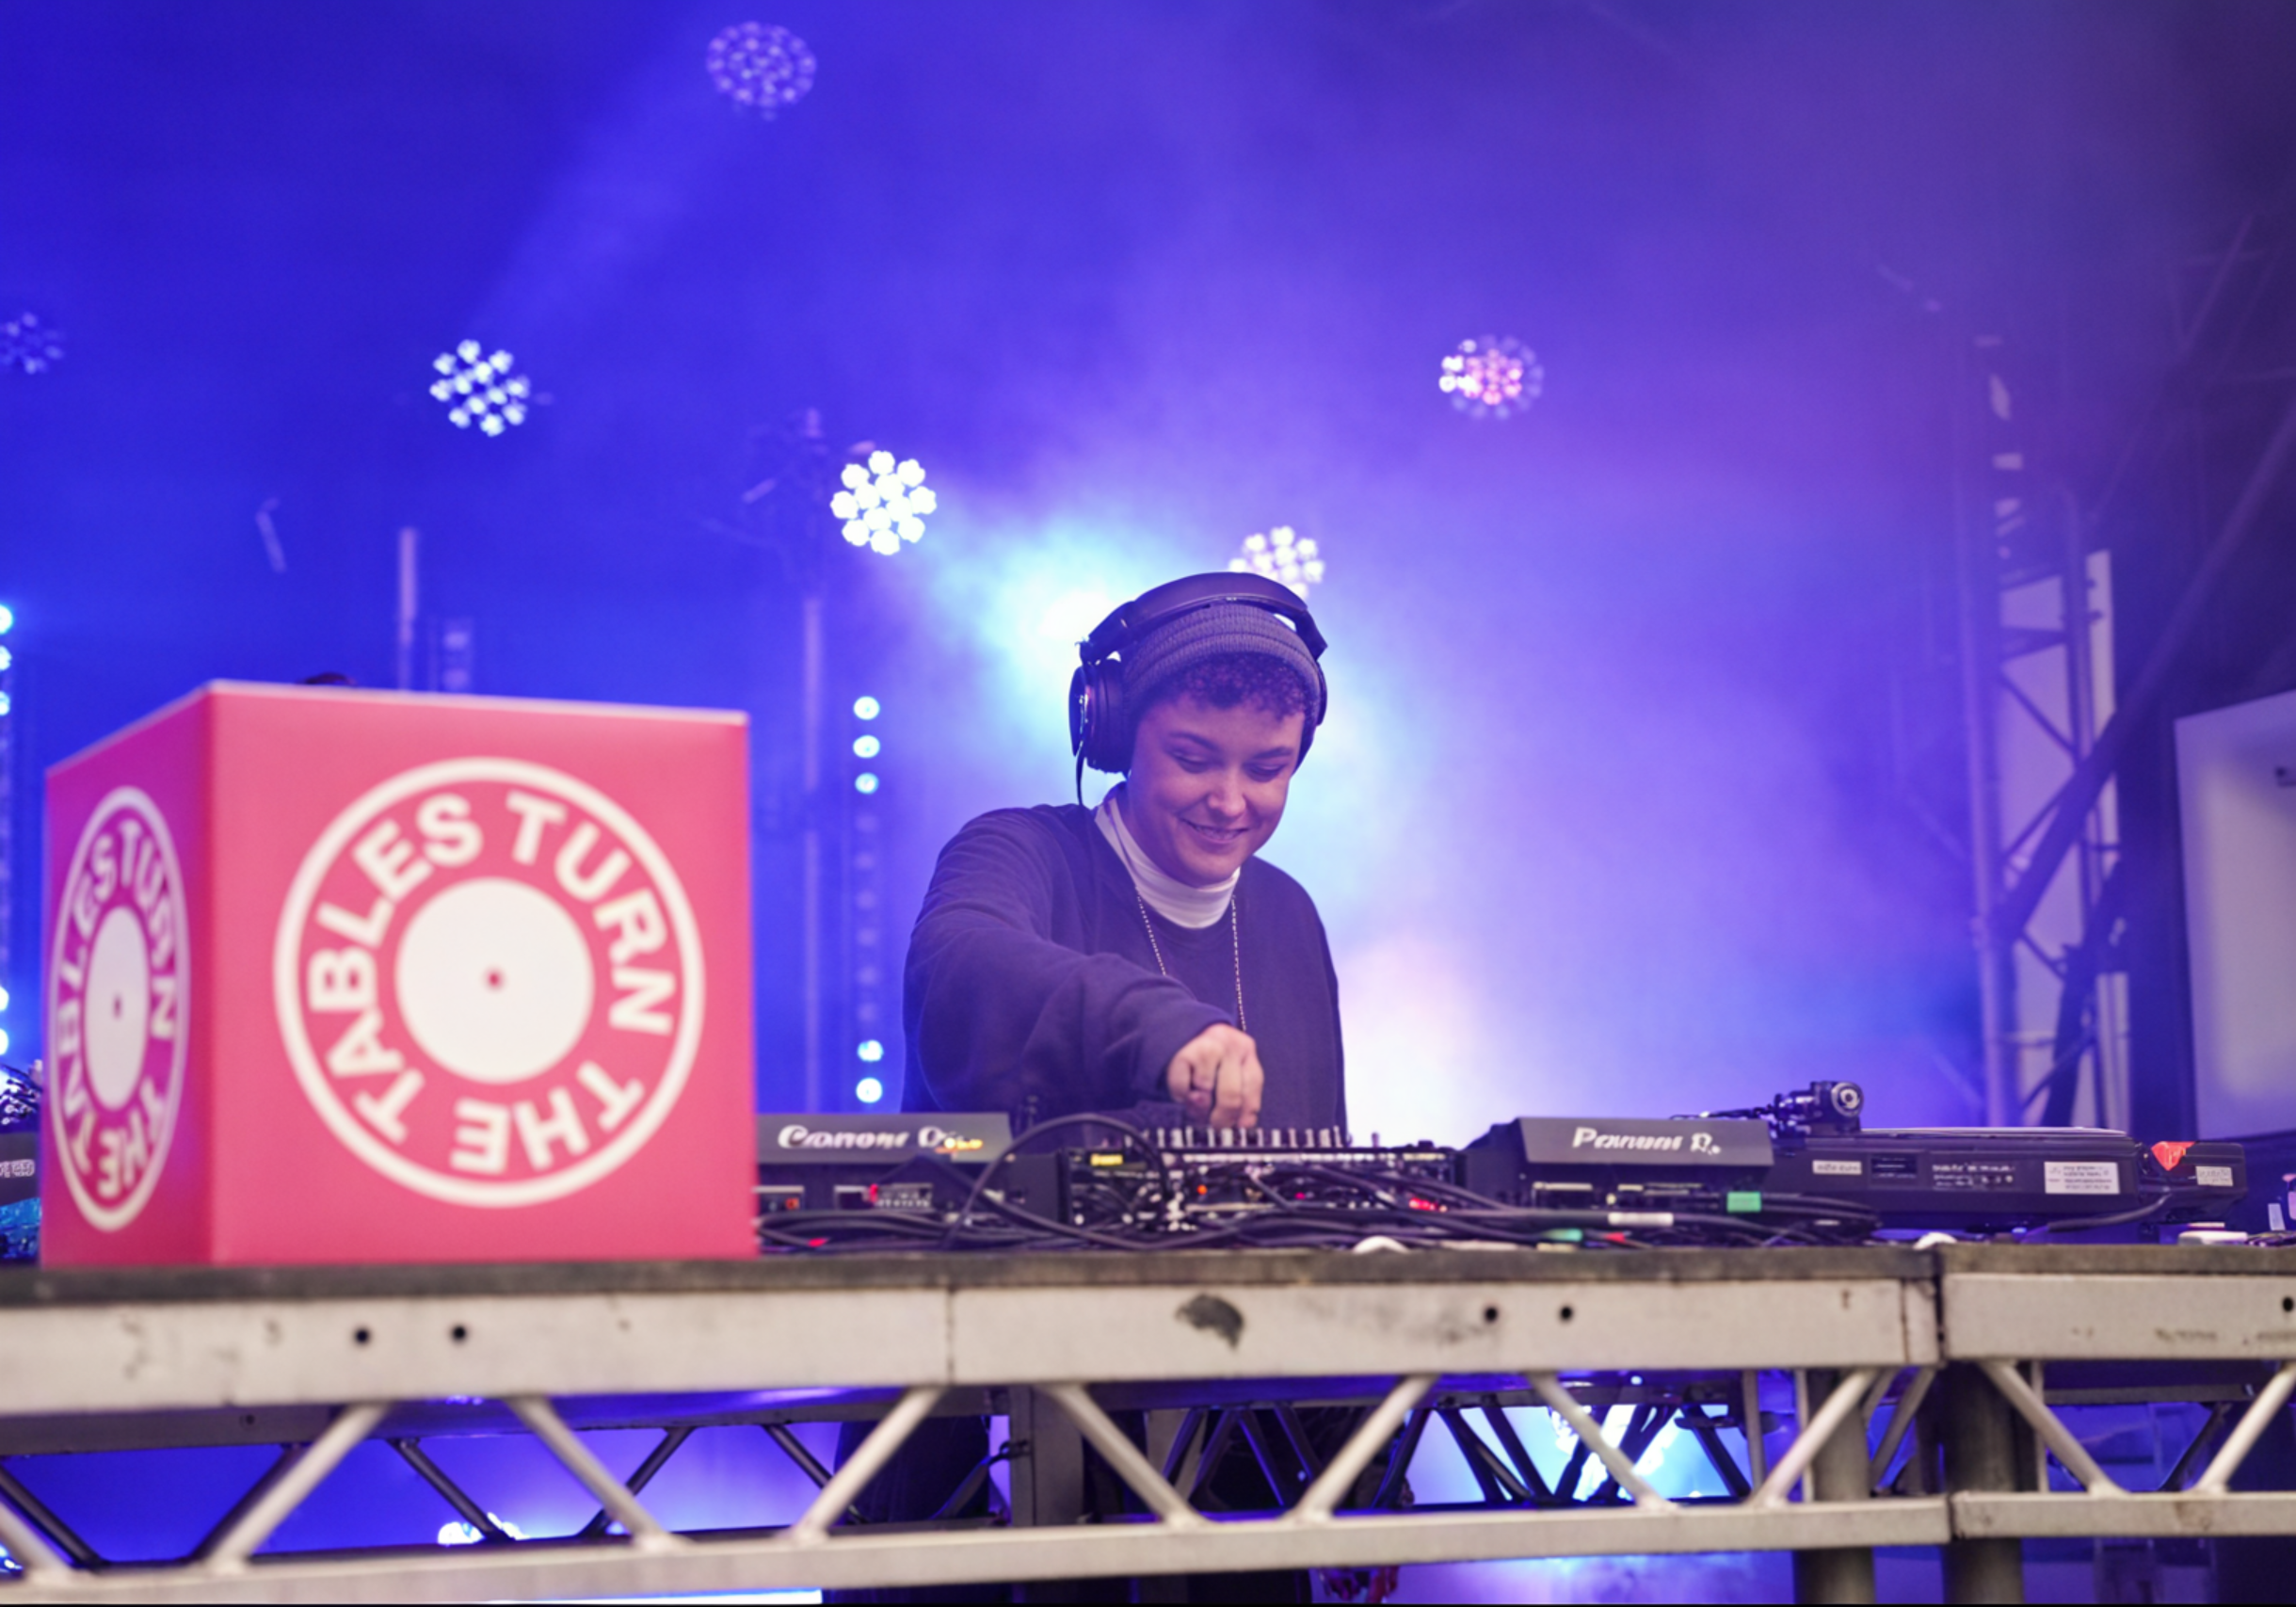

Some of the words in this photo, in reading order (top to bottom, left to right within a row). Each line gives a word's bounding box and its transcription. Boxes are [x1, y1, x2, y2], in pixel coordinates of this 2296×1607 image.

[306, 793, 485, 1145] TABLES
[504, 789, 679, 1037] TURN
[449, 1059, 646, 1176] THE
